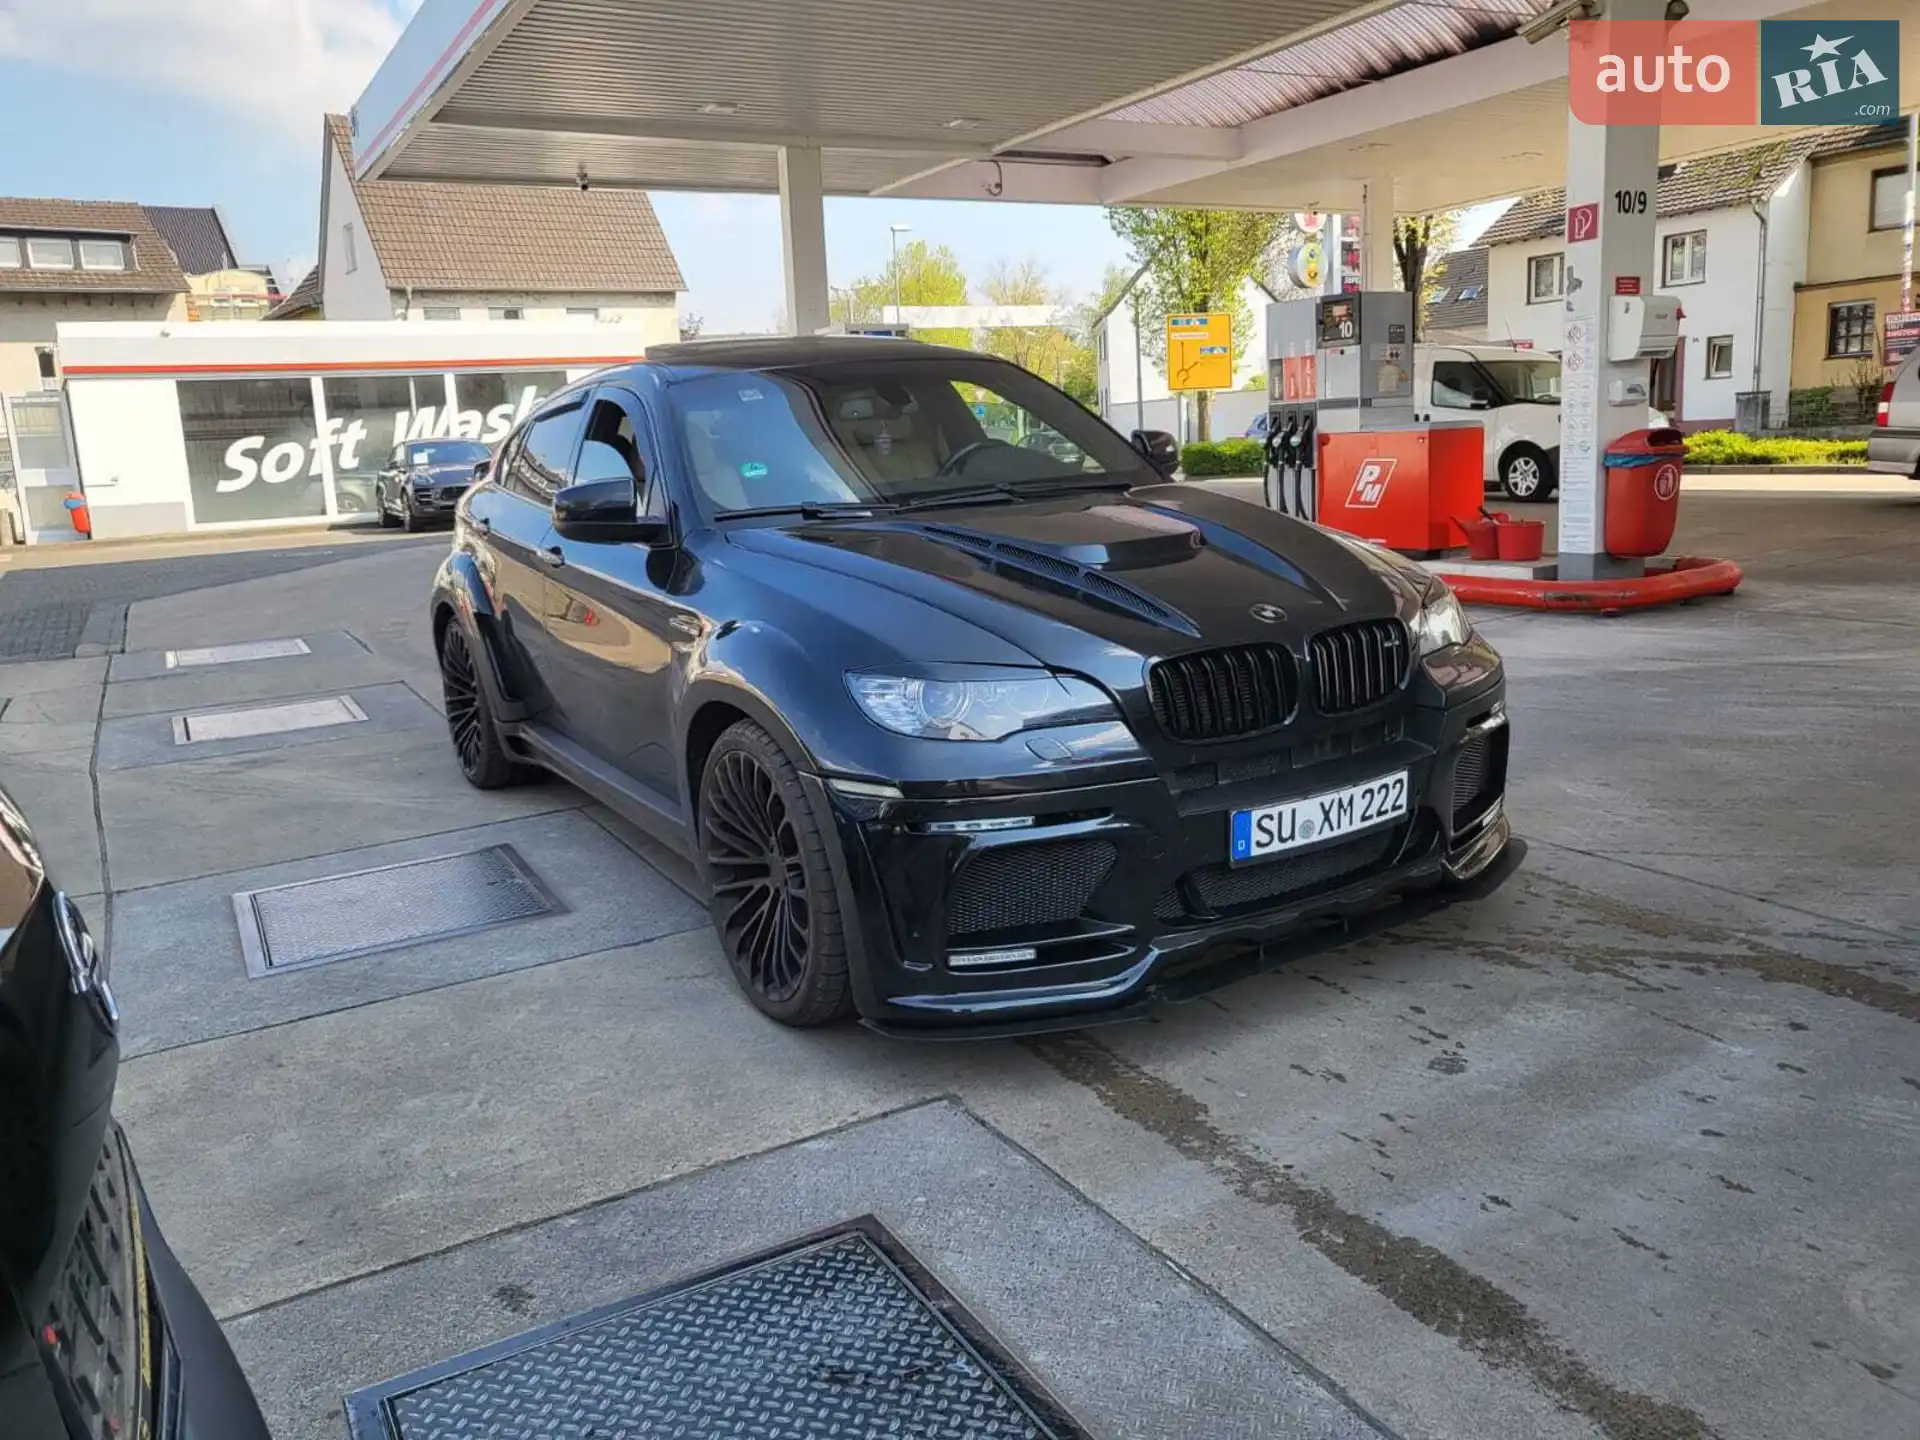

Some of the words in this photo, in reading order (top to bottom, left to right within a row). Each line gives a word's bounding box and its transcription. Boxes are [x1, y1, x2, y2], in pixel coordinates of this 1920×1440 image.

[1614, 189, 1648, 215] 10/9
[1338, 320, 1353, 338] 10
[216, 417, 367, 493] Soft
[1255, 808, 1297, 848] SU
[1318, 794, 1354, 836] XM
[1360, 778, 1404, 824] 222
